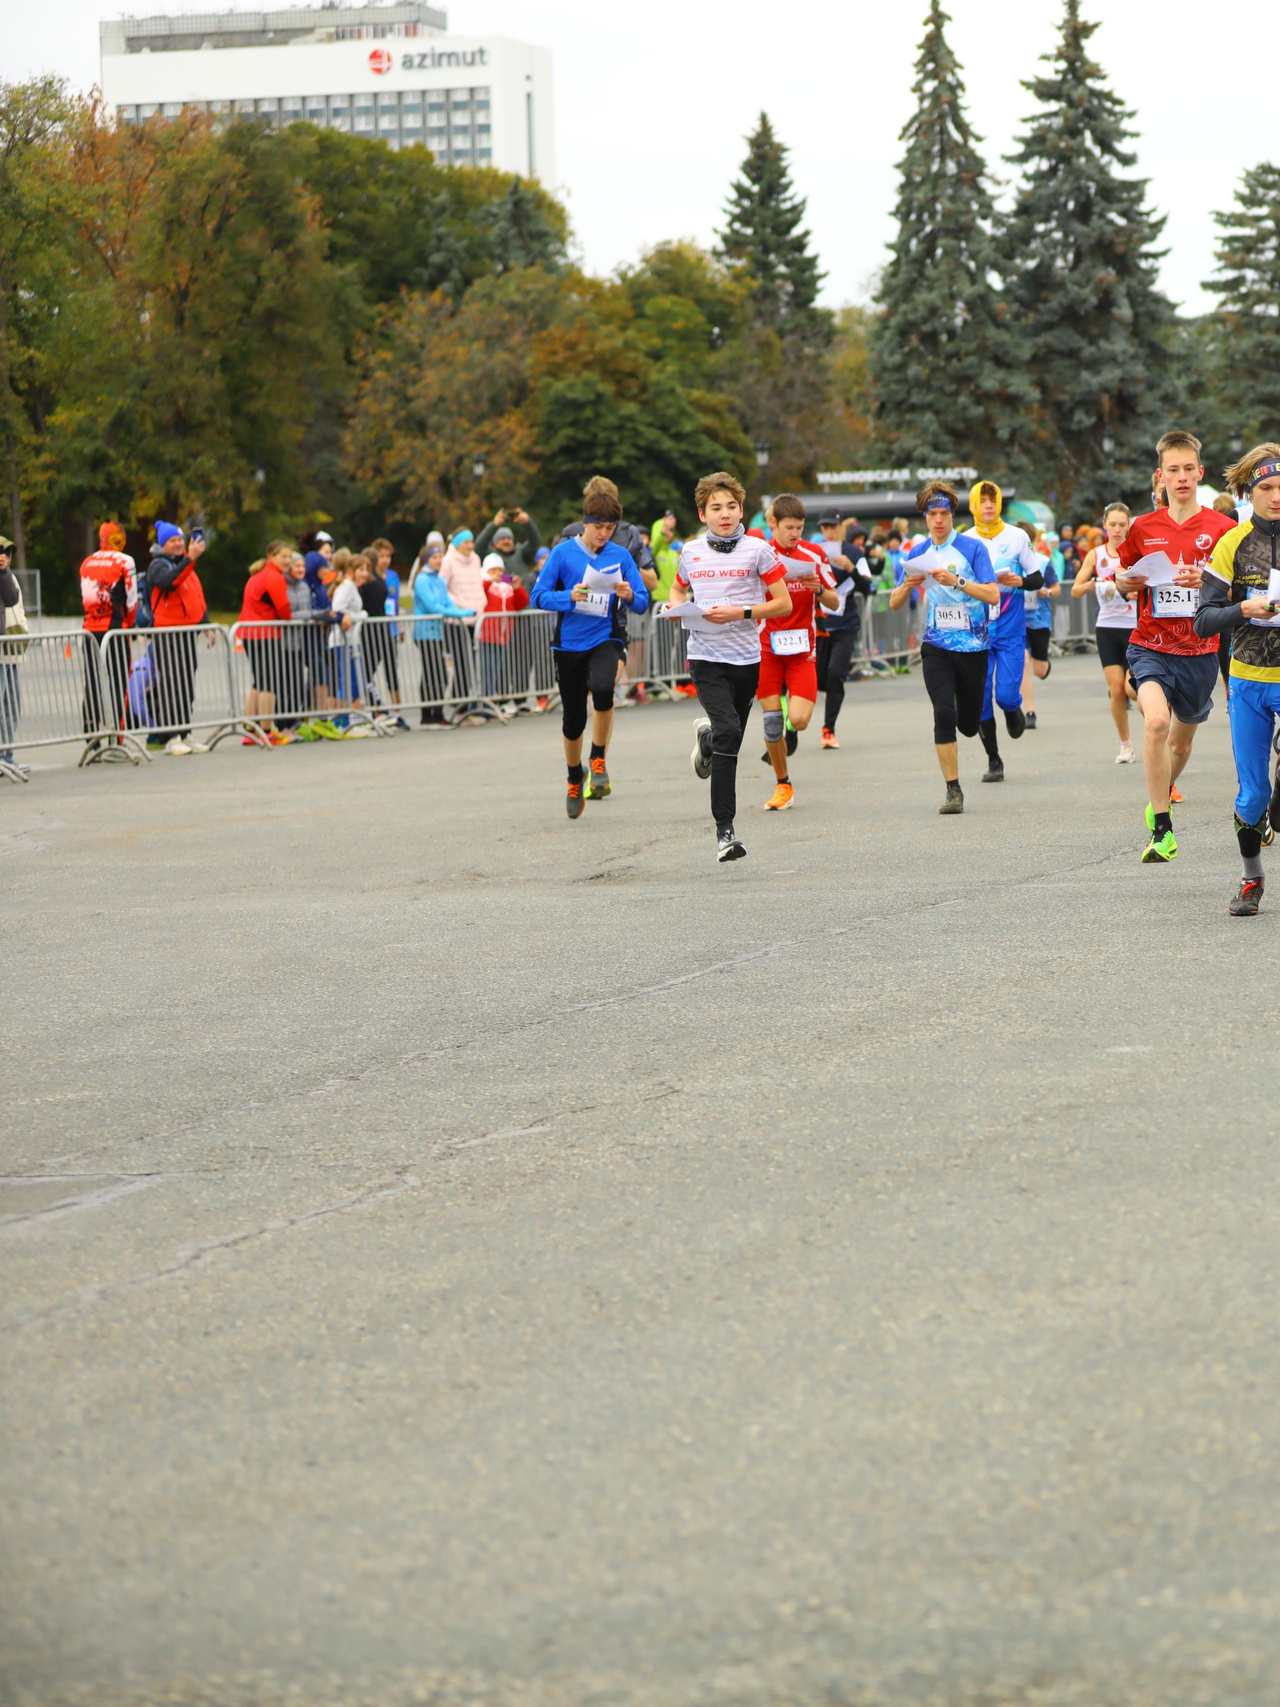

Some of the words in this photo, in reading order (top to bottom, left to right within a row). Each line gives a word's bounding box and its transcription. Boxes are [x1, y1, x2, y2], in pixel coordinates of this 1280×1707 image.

[402, 46, 487, 69] azimut
[816, 469, 910, 484] УЛЬЯНОВСКАЯ
[916, 466, 978, 480] ОБЛАСТЬ
[689, 569, 715, 579] NORD
[718, 569, 752, 577] WEST
[1157, 590, 1192, 604] 325.1
[936, 609, 962, 620] 305.1
[776, 636, 802, 647] 322.1
